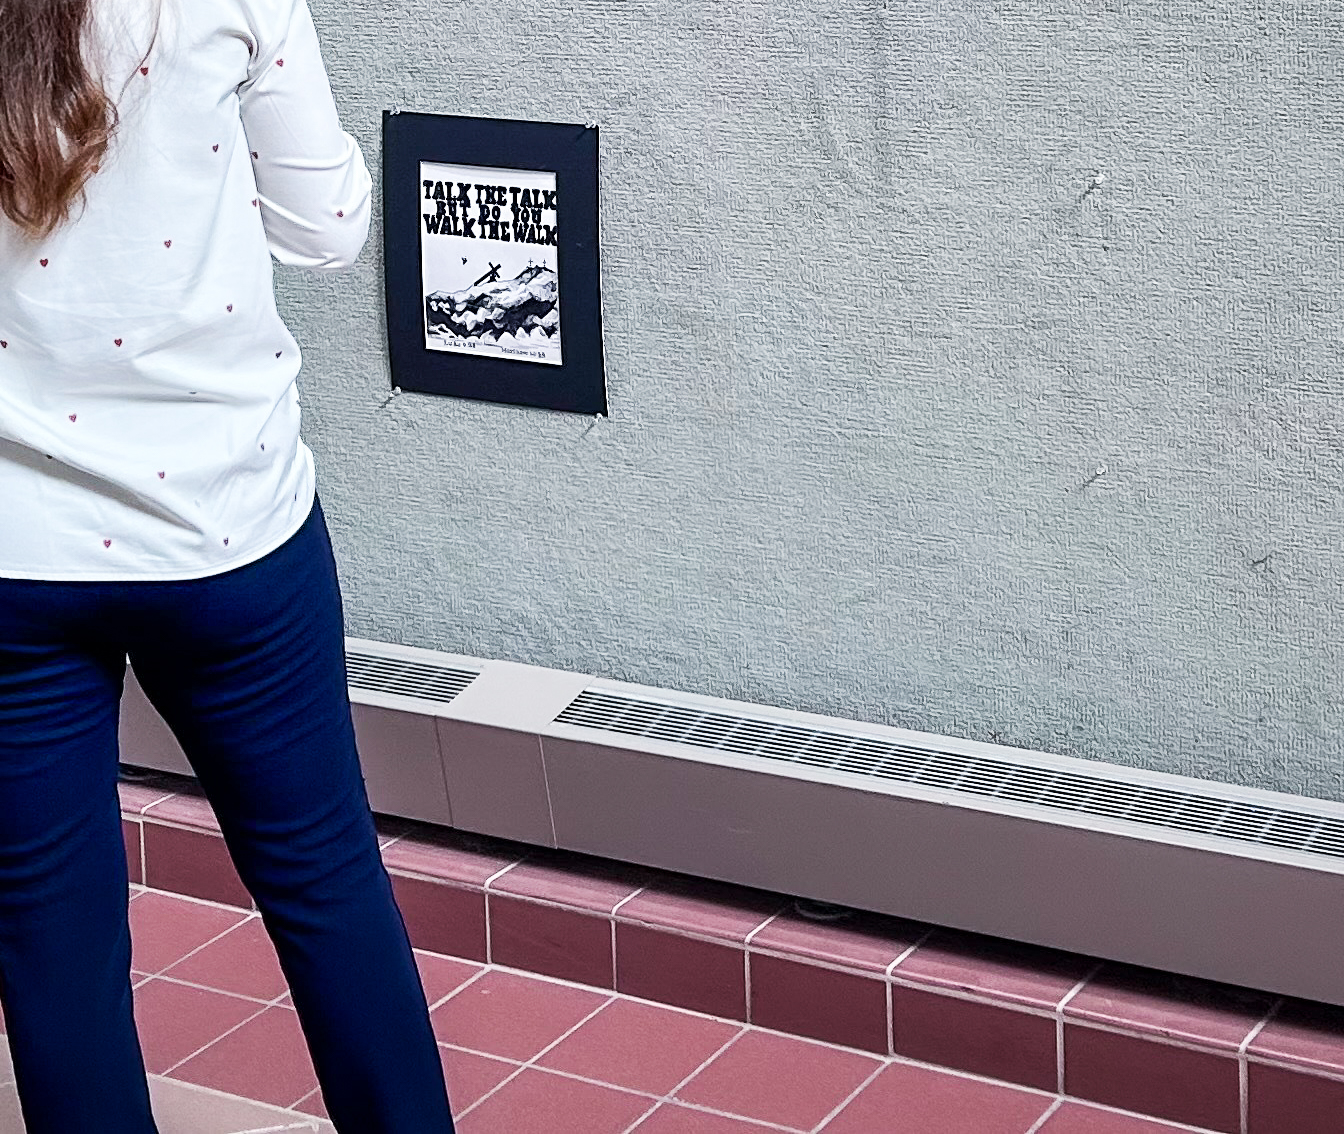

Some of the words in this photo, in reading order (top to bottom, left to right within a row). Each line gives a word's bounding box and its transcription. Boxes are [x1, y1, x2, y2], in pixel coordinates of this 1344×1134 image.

[422, 180, 471, 208] TALK
[474, 184, 507, 206] THE
[509, 187, 557, 210] TALK
[436, 201, 468, 218] BUT
[479, 204, 501, 222] DO
[511, 203, 543, 224] YOU
[423, 213, 476, 239] WALK
[478, 220, 510, 242] THE
[512, 224, 558, 246] WALK
